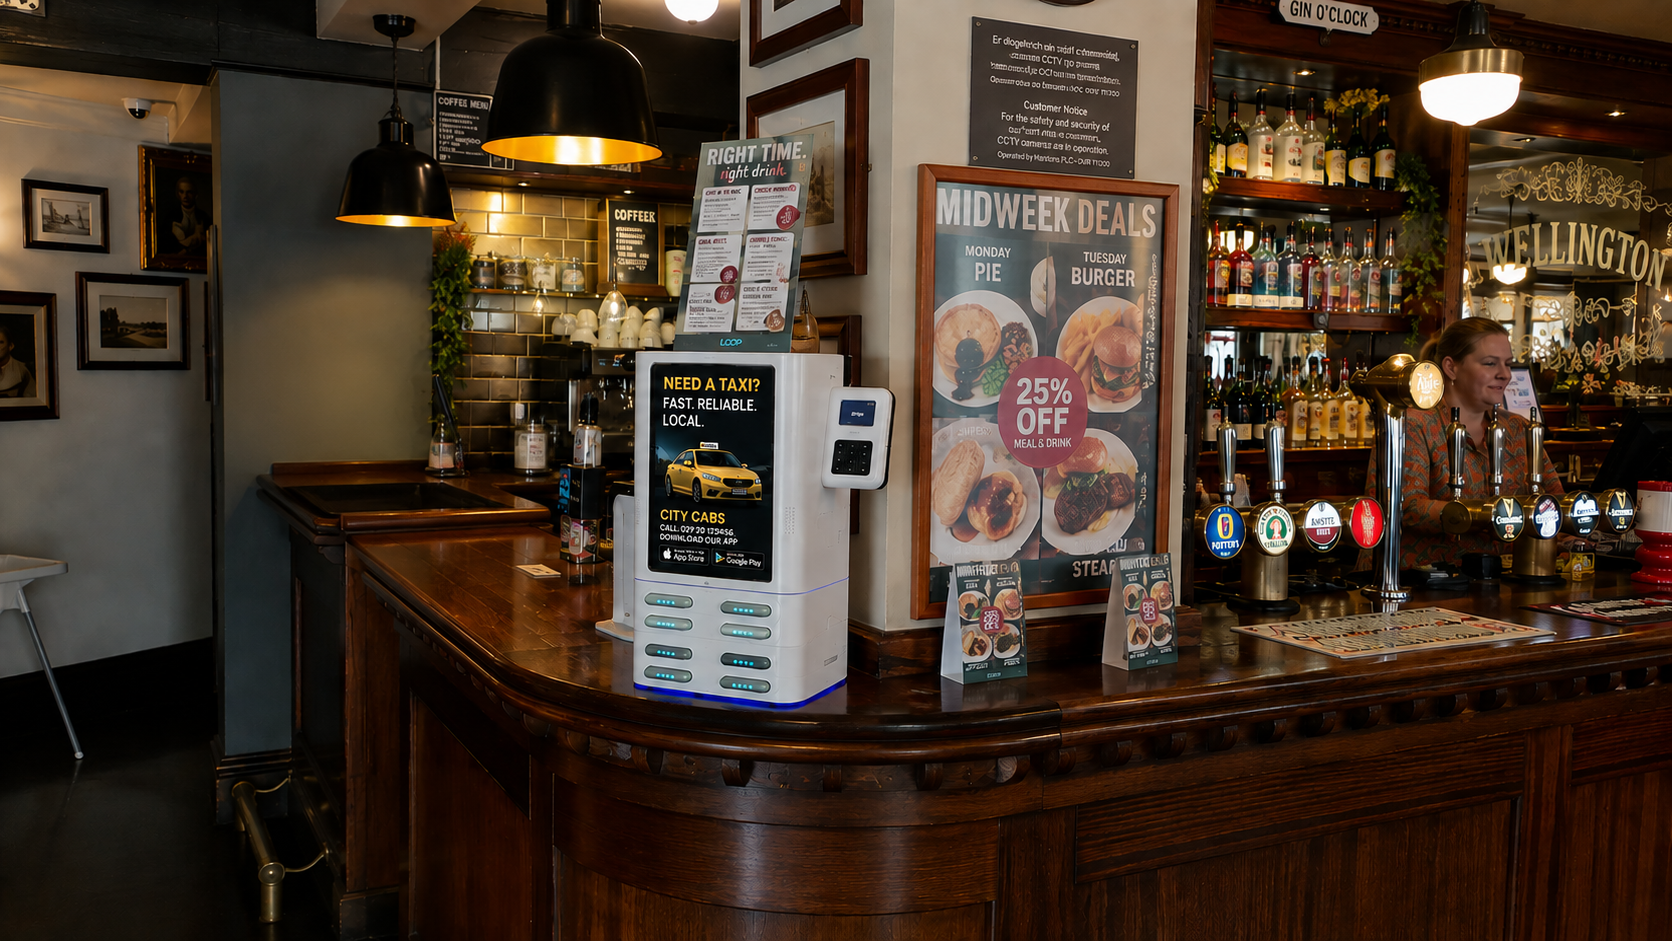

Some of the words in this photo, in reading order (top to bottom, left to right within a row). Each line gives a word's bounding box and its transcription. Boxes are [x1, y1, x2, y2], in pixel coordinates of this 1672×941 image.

[1290, 0, 1312, 18] GIN
[1316, 4, 1368, 28] O'CLOCK
[1023, 100, 1061, 113] Customer
[1063, 105, 1088, 116] Notice
[1001, 112, 1014, 121] For
[1015, 113, 1028, 123] the
[1029, 116, 1054, 128] safety
[1055, 119, 1069, 128] and
[1101, 122, 1110, 132] of
[706, 145, 757, 166] RIGHT
[761, 141, 807, 162] TIME.
[720, 164, 749, 184] right
[936, 187, 1071, 233] MIDWEEK
[1077, 198, 1157, 239] DEALS
[965, 245, 1011, 259] MONDAY
[1083, 251, 1127, 265] TUESDAY
[1479, 222, 1668, 291] WELLINGTON
[975, 262, 1002, 283] PIE
[1071, 266, 1136, 288] BURGER
[719, 338, 743, 347] LOOP
[663, 376, 702, 391] NEED
[704, 377, 716, 391] A
[718, 377, 761, 392] TAXI?
[1016, 377, 1073, 405] 25%
[663, 396, 695, 410] FAST.
[697, 397, 757, 412] RELIABLE.
[662, 413, 705, 428] LOCAL.
[1016, 407, 1069, 436] OFF
[1014, 438, 1037, 449] MEAL
[1038, 439, 1045, 448] &
[1046, 437, 1072, 448] DRINK
[660, 508, 689, 522] CITY
[691, 511, 726, 525] CABS
[704, 536, 722, 545] OUR
[722, 537, 739, 546] APP
[673, 553, 687, 562] App
[687, 553, 705, 563] Store
[726, 556, 748, 567] Google
